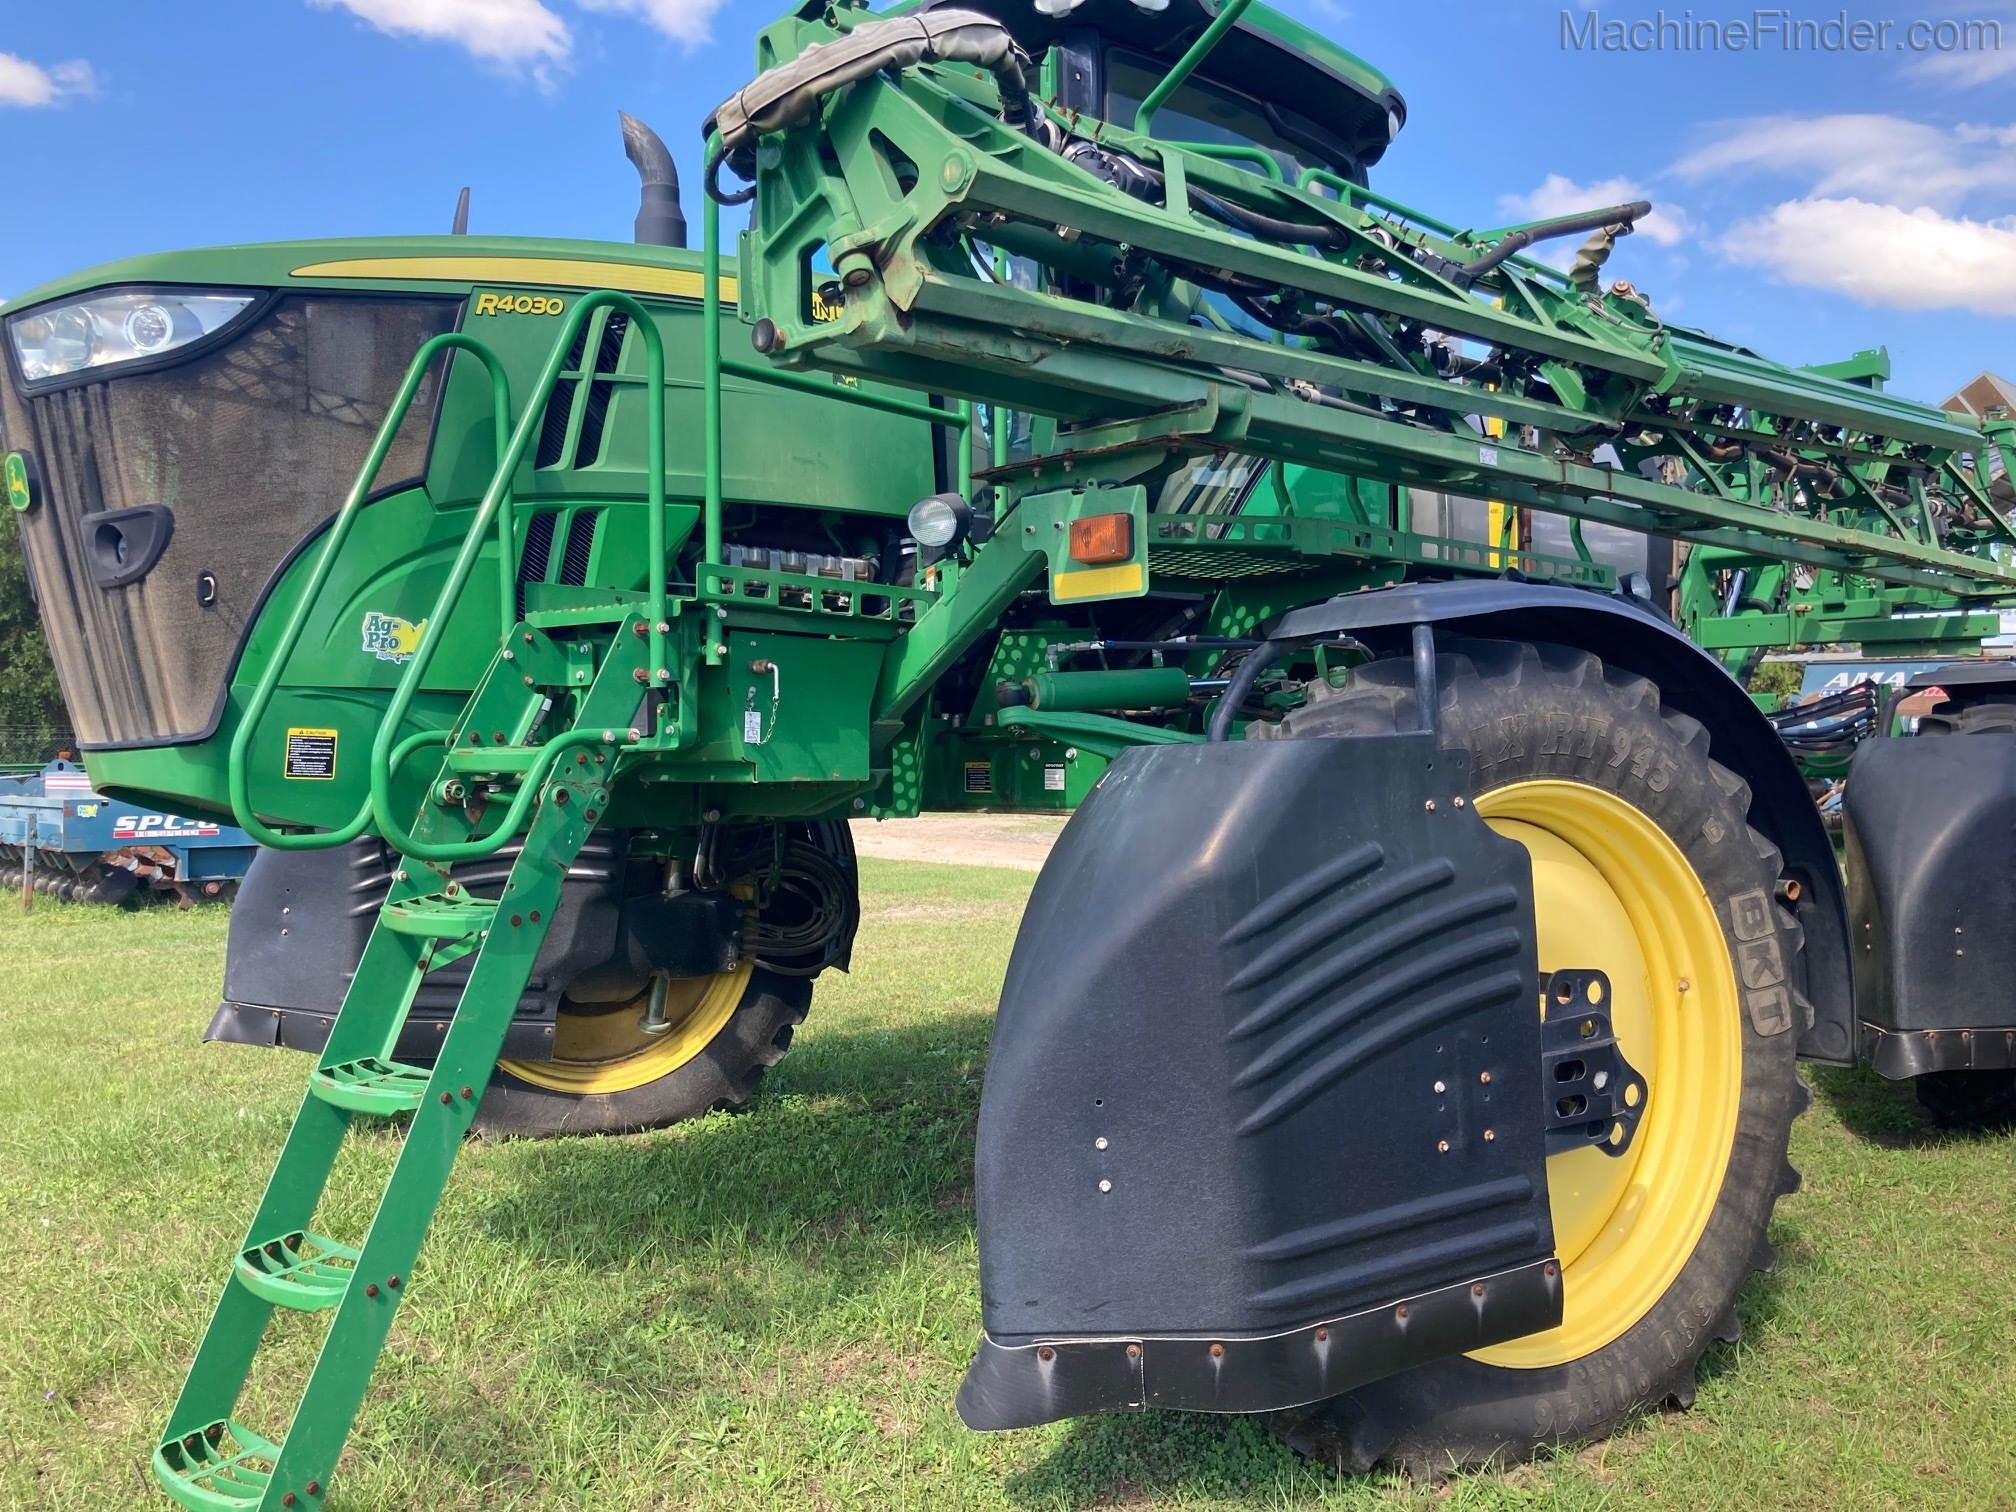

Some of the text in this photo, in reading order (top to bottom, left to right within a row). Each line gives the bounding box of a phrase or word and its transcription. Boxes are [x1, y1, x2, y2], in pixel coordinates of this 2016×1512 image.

[475, 293, 565, 316] R4030
[366, 632, 399, 649] Pro
[1540, 712, 1610, 760] RT
[1607, 728, 1679, 794] 945
[1736, 893, 1788, 1030] BKT
